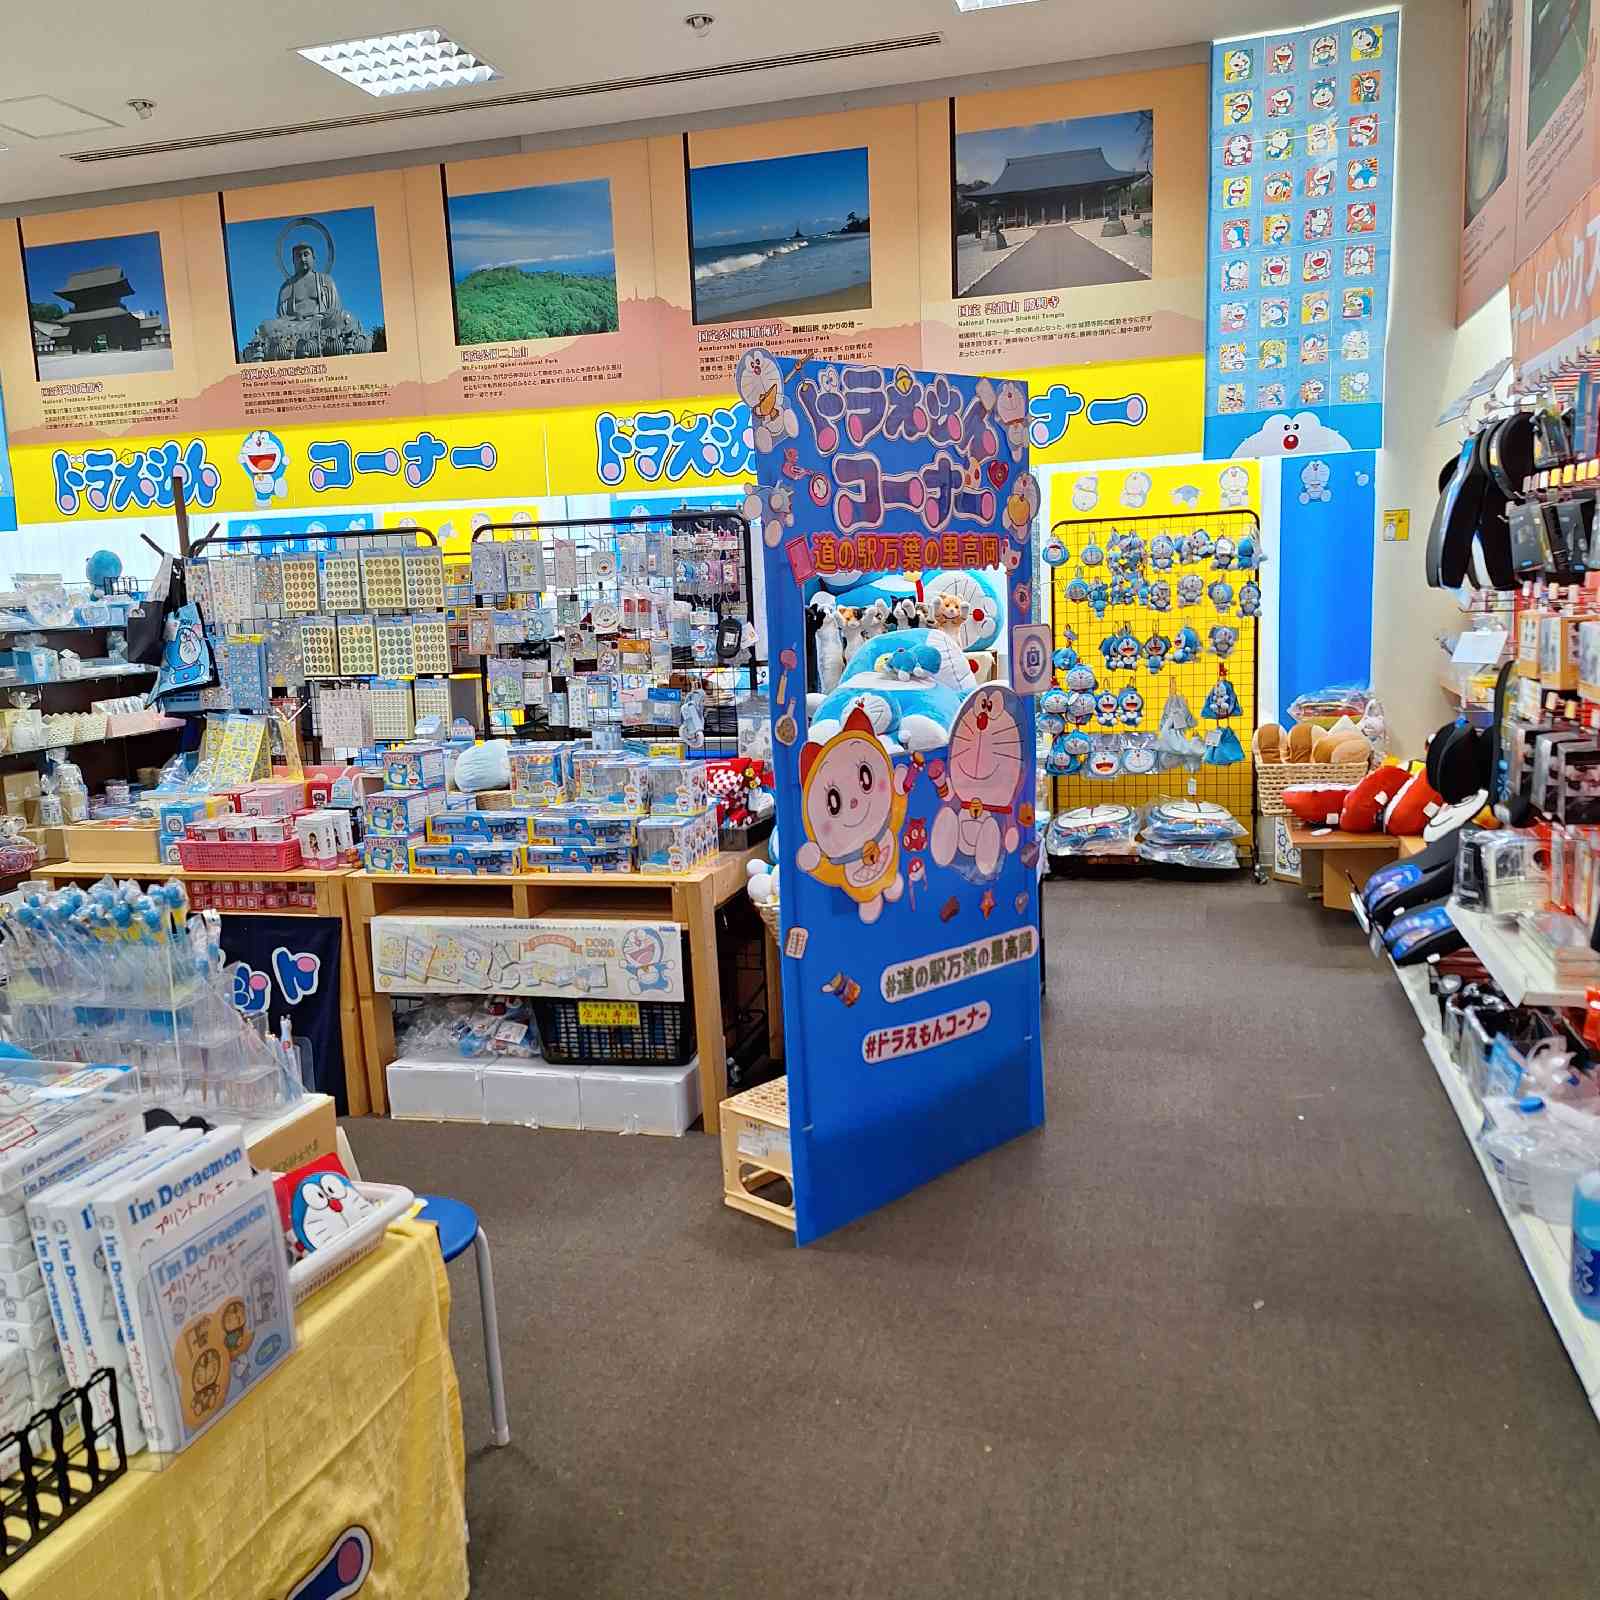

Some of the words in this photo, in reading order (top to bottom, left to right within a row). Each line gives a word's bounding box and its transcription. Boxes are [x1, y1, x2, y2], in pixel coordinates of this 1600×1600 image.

[595, 401, 758, 486] ドラえも
[798, 364, 999, 466] ドラえもん
[53, 438, 222, 515] ドラえもん
[308, 431, 498, 492] コーナー
[832, 451, 997, 534] コーナー
[812, 532, 1002, 574] 道の駅万葉の里高岡
[864, 1008, 988, 1060] #ドラえもんコーナー
[128, 1198, 156, 1226] I'm
[158, 1147, 243, 1207] Doraemon
[184, 1203, 266, 1266] Doraemon
